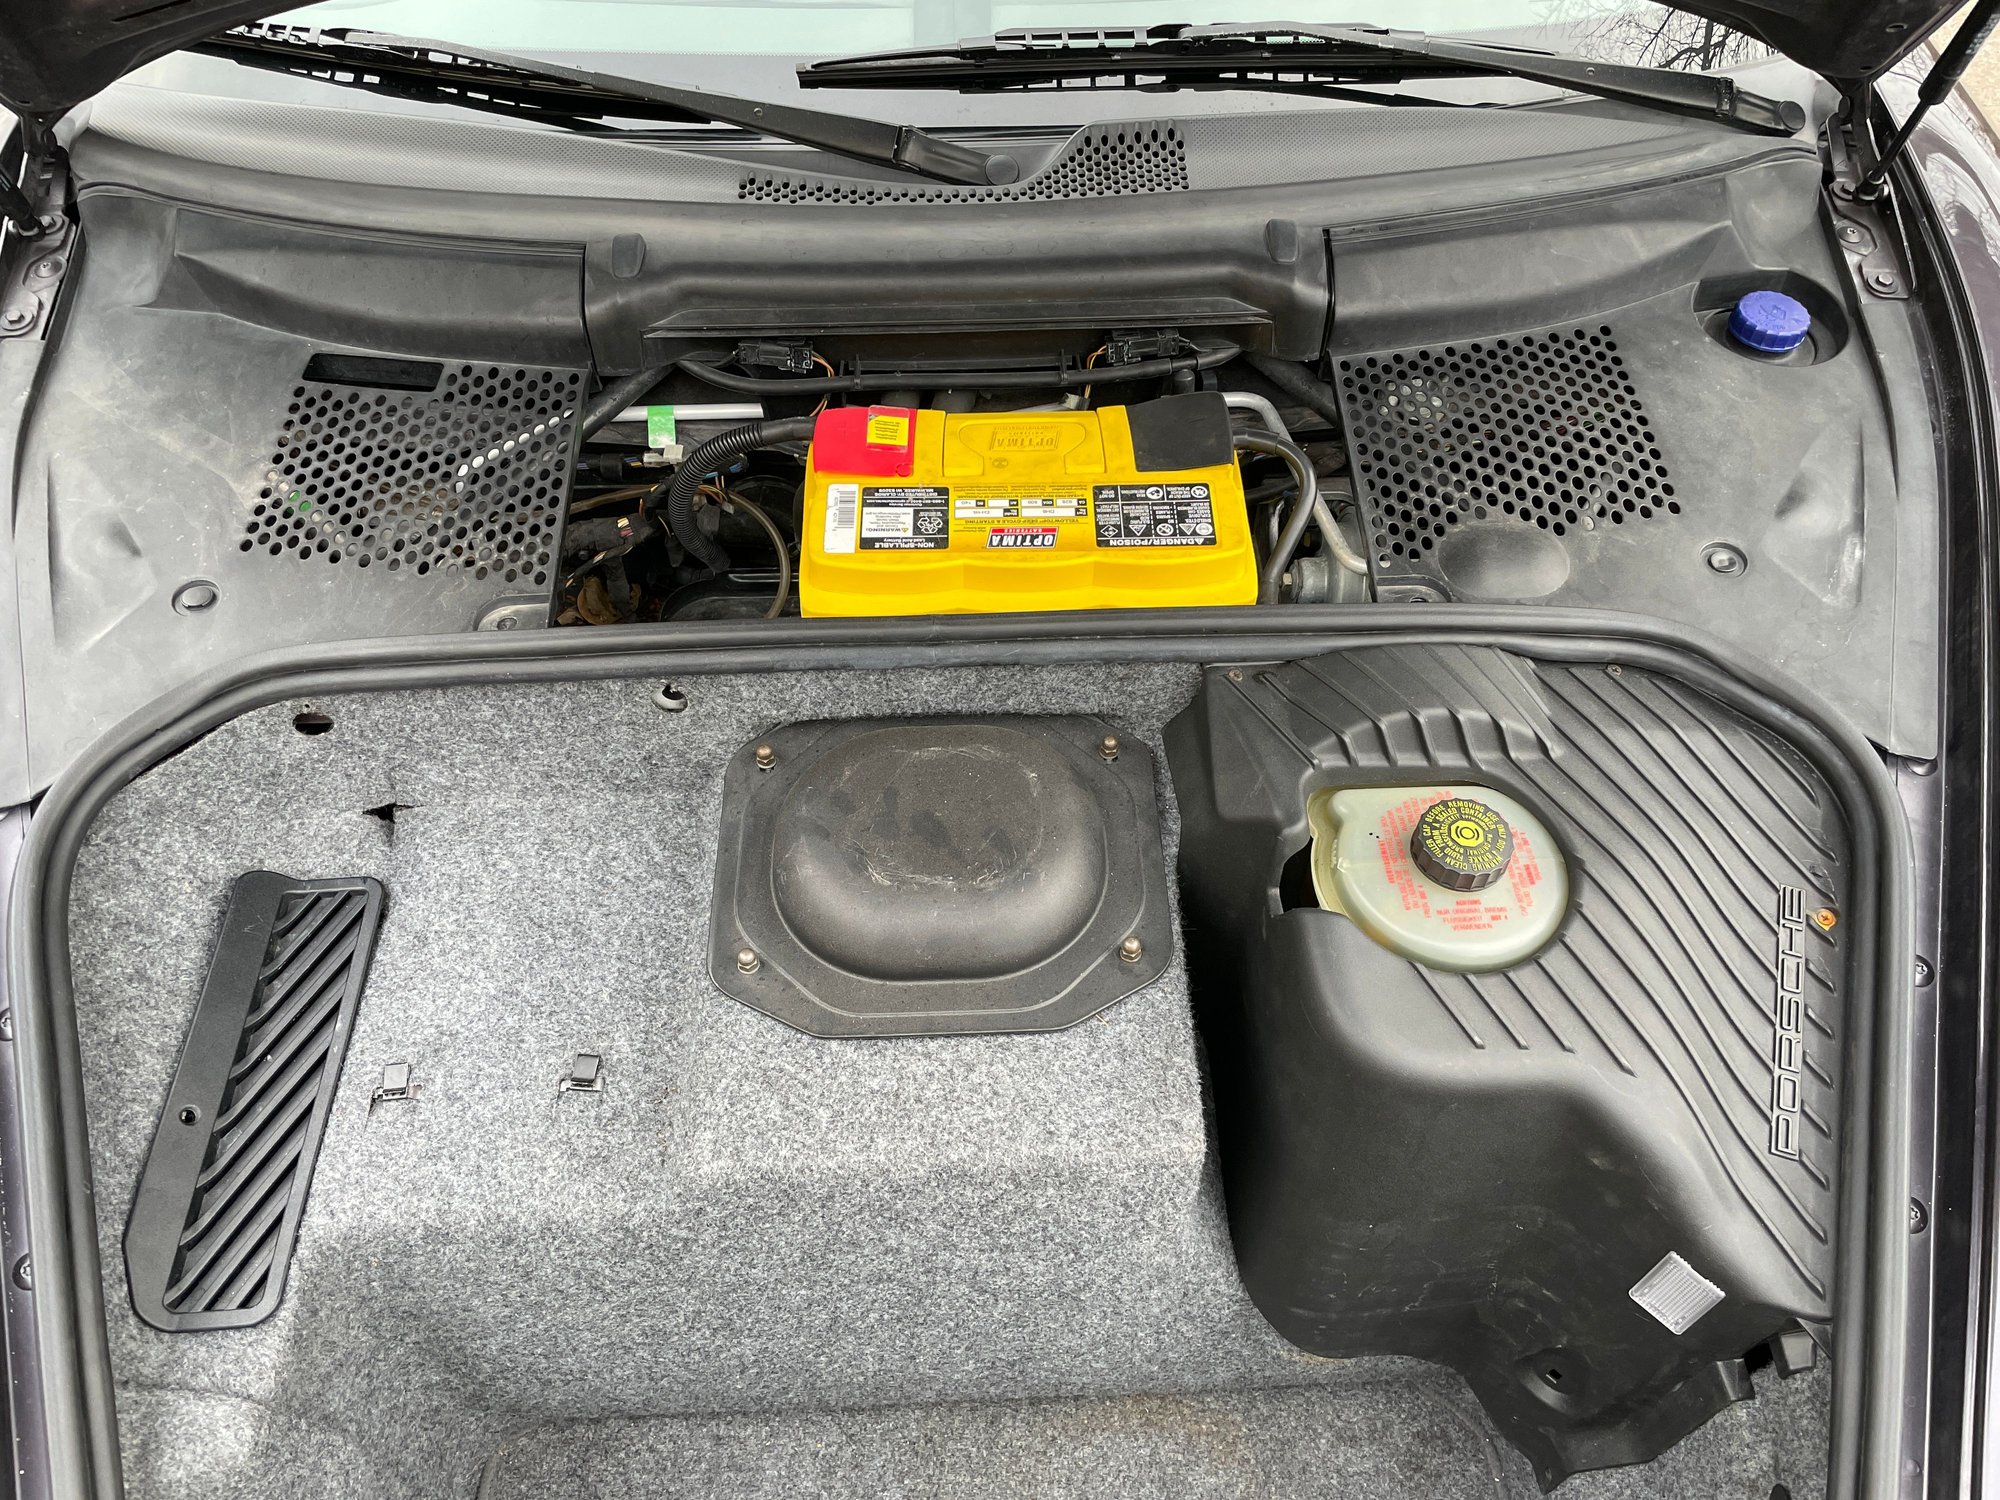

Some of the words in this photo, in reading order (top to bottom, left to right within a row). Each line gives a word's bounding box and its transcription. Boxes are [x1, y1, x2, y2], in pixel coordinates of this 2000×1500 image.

[992, 535, 1053, 546] OPTIMA
[1425, 804, 1446, 823] BEFORE
[1448, 801, 1484, 812] REMOVING
[1436, 808, 1457, 821] SEALED
[1460, 807, 1496, 830] CONTAINER
[1486, 811, 1500, 823] USE
[1497, 824, 1506, 838] ONLY
[1432, 830, 1445, 847] FROM
[1426, 839, 1444, 857] FILLER
[1444, 847, 1464, 861] FLUID
[1445, 857, 1468, 870] CLEAN
[1469, 853, 1492, 863] BRAKE
[1473, 855, 1503, 871] WARNING
[1776, 883, 1806, 1156] PORSCHE
